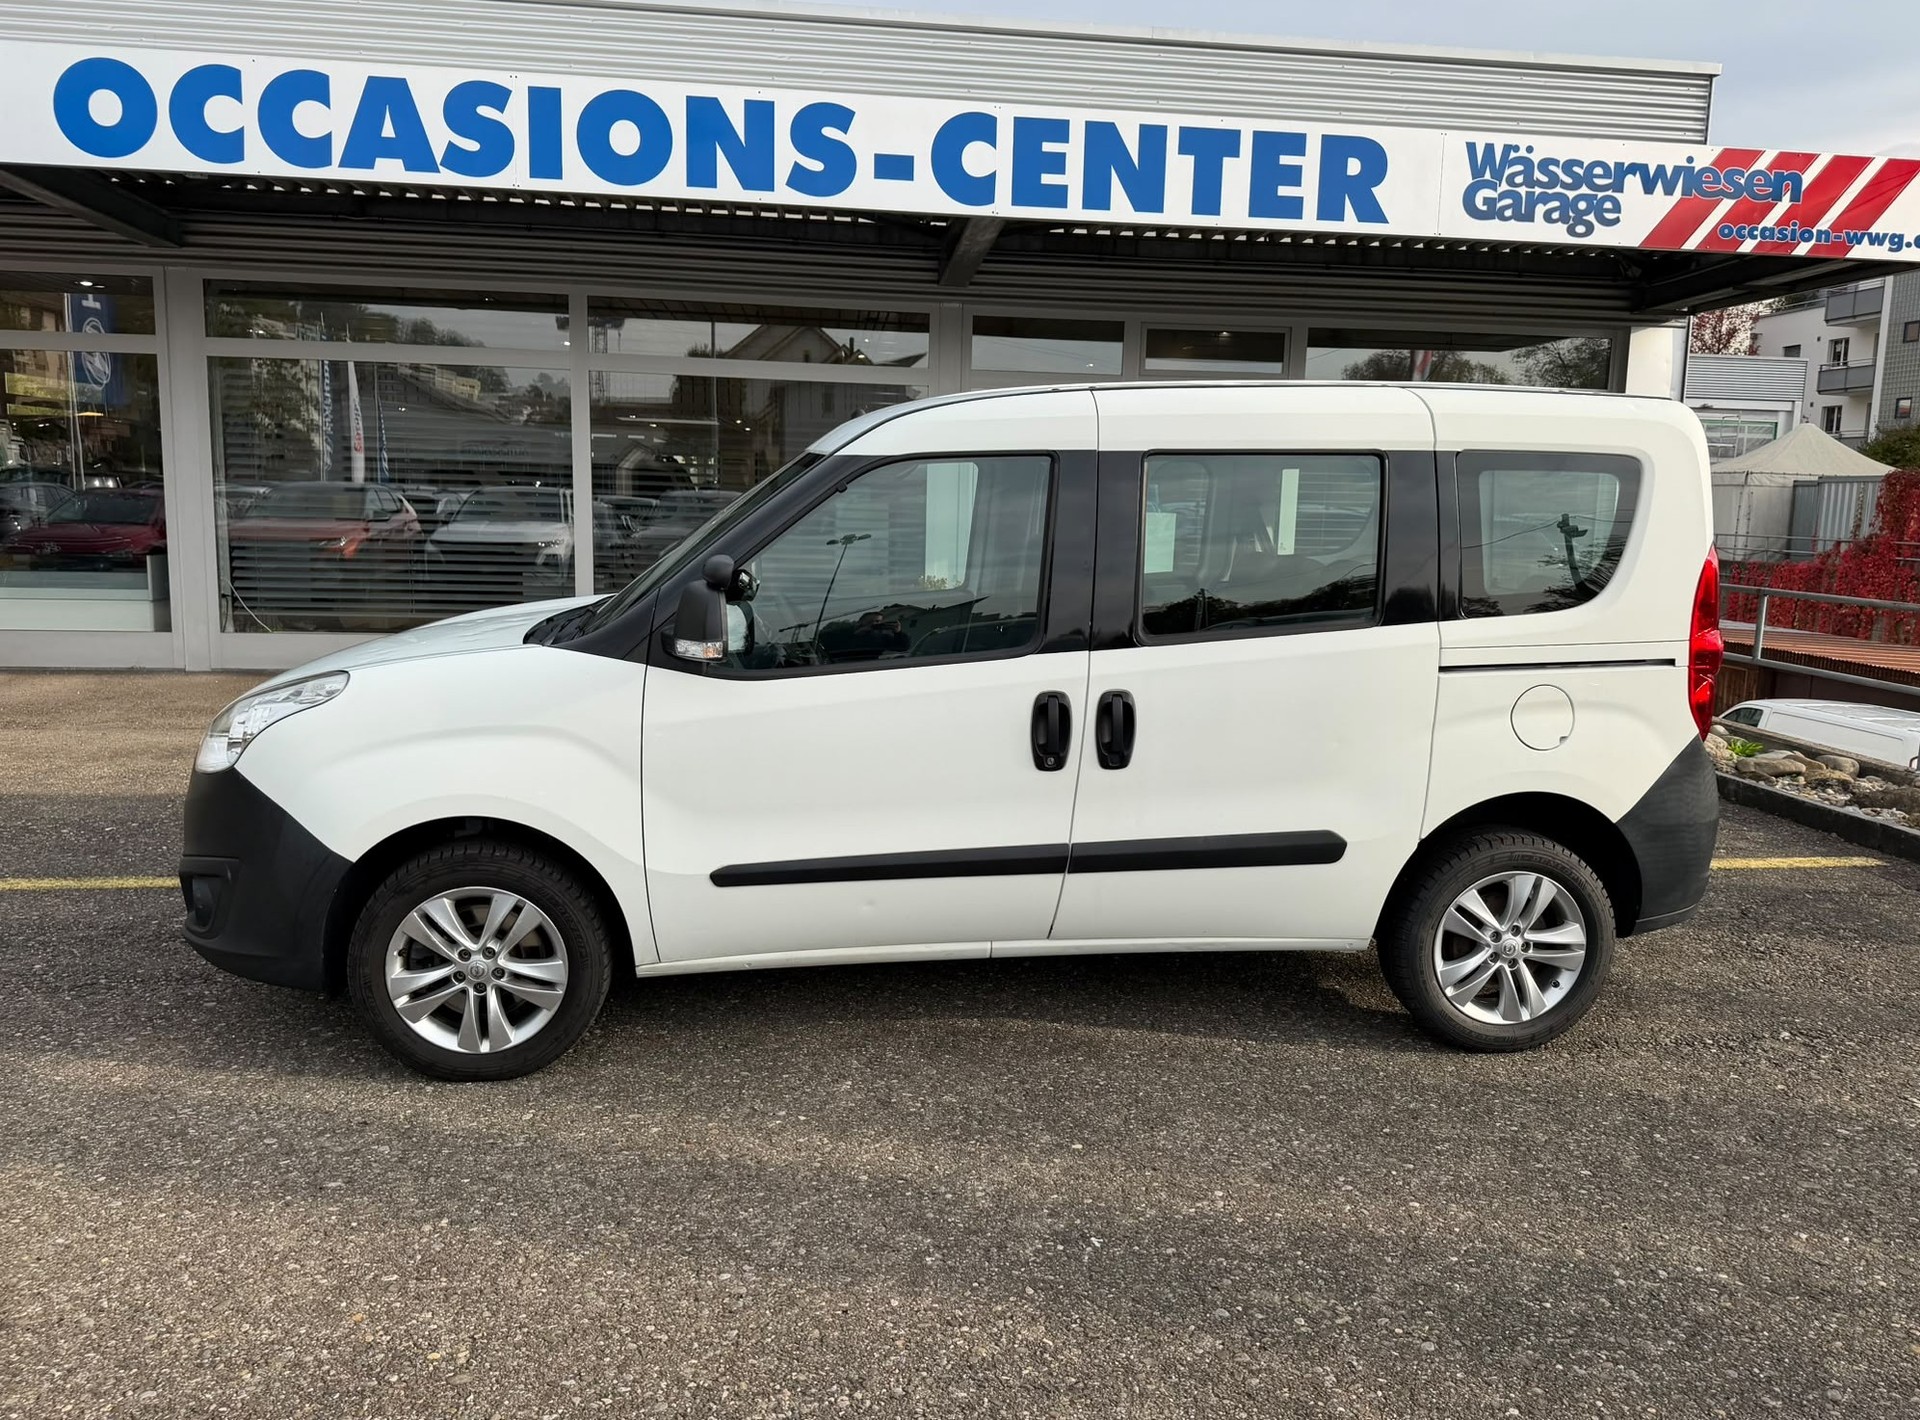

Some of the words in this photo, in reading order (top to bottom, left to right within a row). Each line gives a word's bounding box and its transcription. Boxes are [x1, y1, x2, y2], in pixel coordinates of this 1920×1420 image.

[53, 57, 1389, 224] OCCASIONS-CENTER
[1466, 141, 1803, 203] Wässerwiesen
[1463, 178, 1621, 238] Garage
